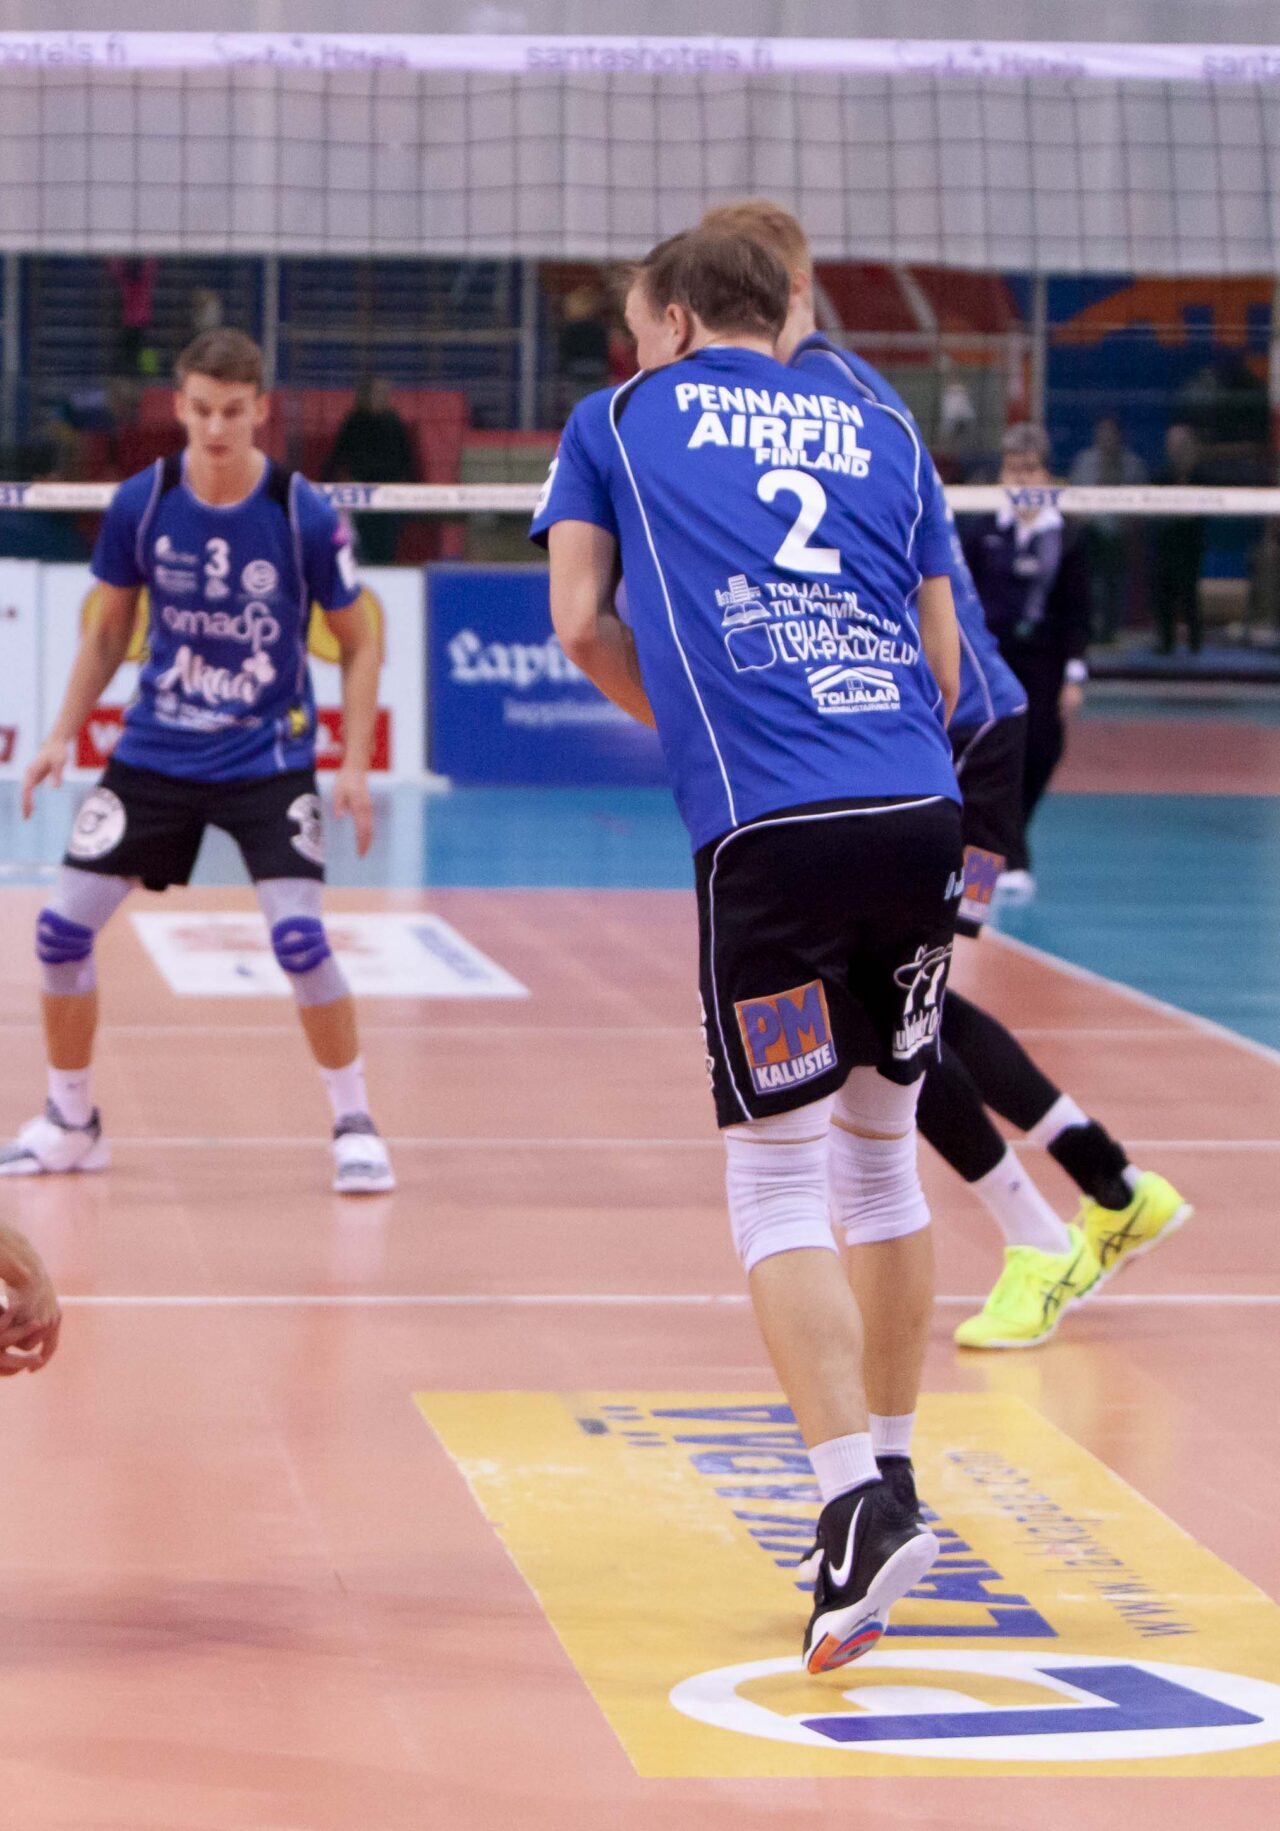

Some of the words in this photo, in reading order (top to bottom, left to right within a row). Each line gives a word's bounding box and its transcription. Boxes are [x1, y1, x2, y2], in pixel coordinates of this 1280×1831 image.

[675, 382, 864, 428] PENNANEN
[687, 412, 871, 460] AIRFIL
[755, 446, 869, 478] FINLAND
[757, 469, 841, 574] 2
[204, 537, 230, 578] 3
[818, 687, 900, 706] TOIJALAN
[741, 985, 828, 1064] PM
[755, 1042, 833, 1090] KALUSTE
